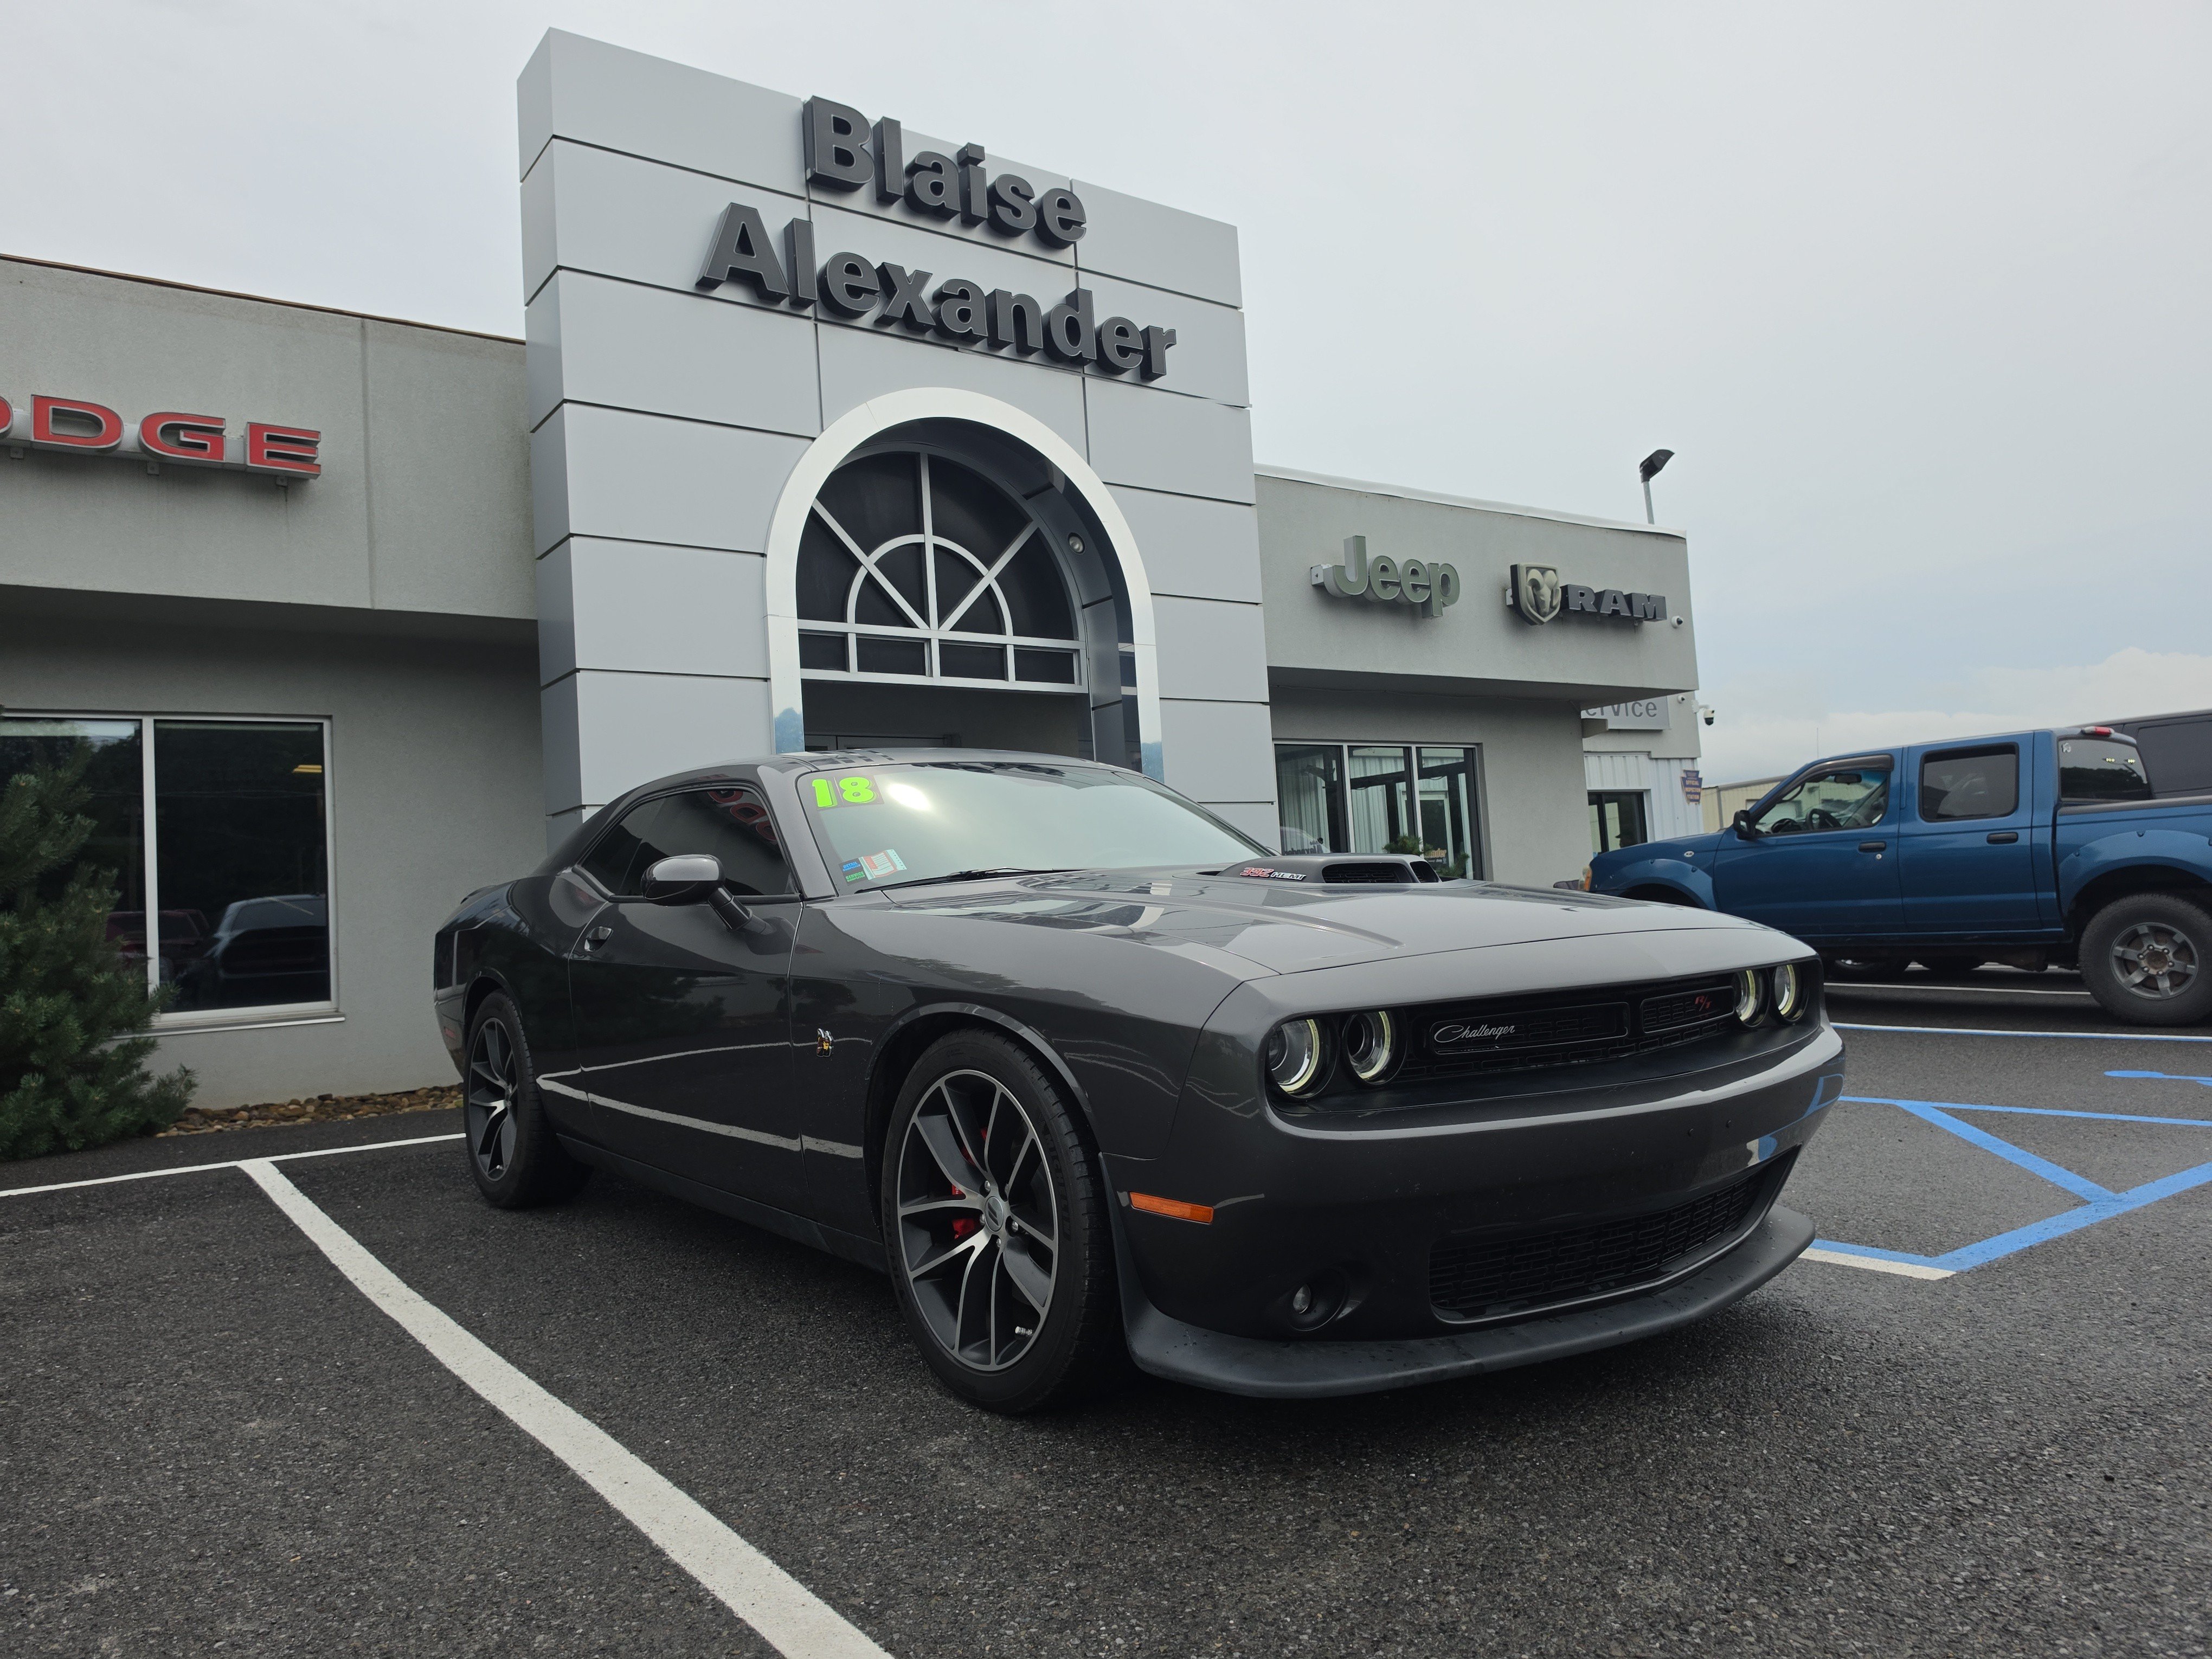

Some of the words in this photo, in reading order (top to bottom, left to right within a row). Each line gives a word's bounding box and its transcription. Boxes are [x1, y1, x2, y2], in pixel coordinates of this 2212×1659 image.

[803, 95, 1086, 249] Blaise
[696, 202, 1176, 382] Alexander
[0, 395, 321, 479] DGE
[1324, 535, 1460, 618] Jeep
[1560, 583, 1667, 622] RAM
[812, 776, 878, 807] 18
[1240, 867, 1274, 878] 392
[1270, 872, 1307, 880] HEMI
[1434, 1024, 1515, 1043] Challenger
[1694, 994, 1712, 1012] R/T
[1045, 1134, 1071, 1241] MICHELIN
